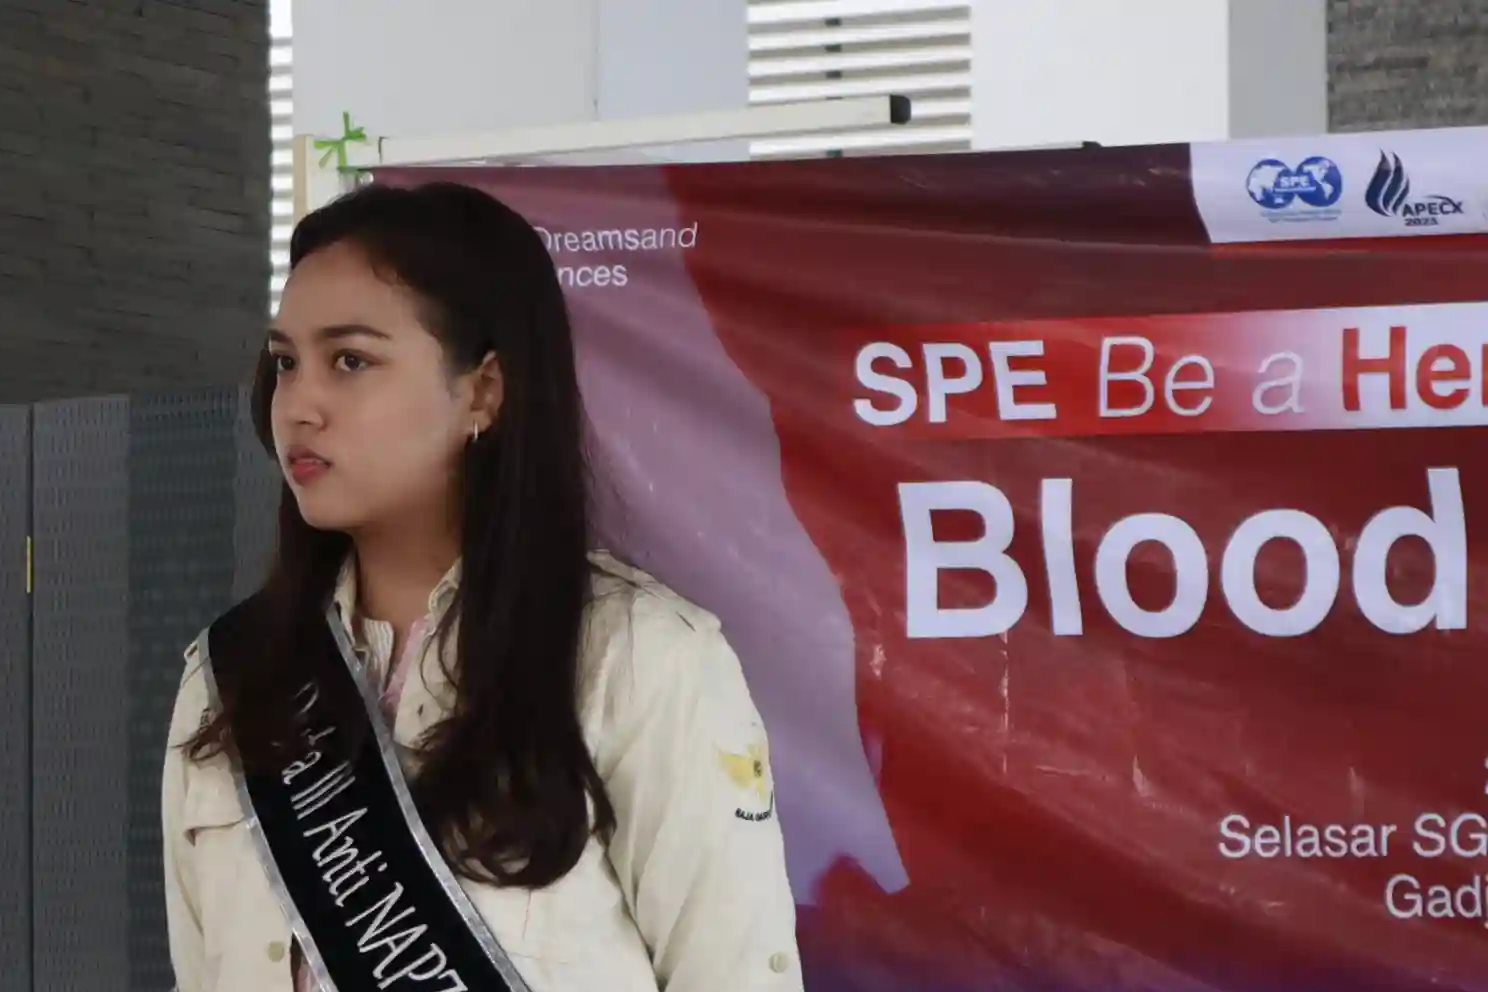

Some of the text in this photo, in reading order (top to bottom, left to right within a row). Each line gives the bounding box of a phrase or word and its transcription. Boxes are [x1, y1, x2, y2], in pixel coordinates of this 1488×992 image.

[558, 264, 628, 287] nces
[851, 325, 1488, 427] SPE Be a He
[897, 467, 1467, 639] Blood
[303, 807, 388, 908] Anti
[1218, 814, 1398, 858] Selasar
